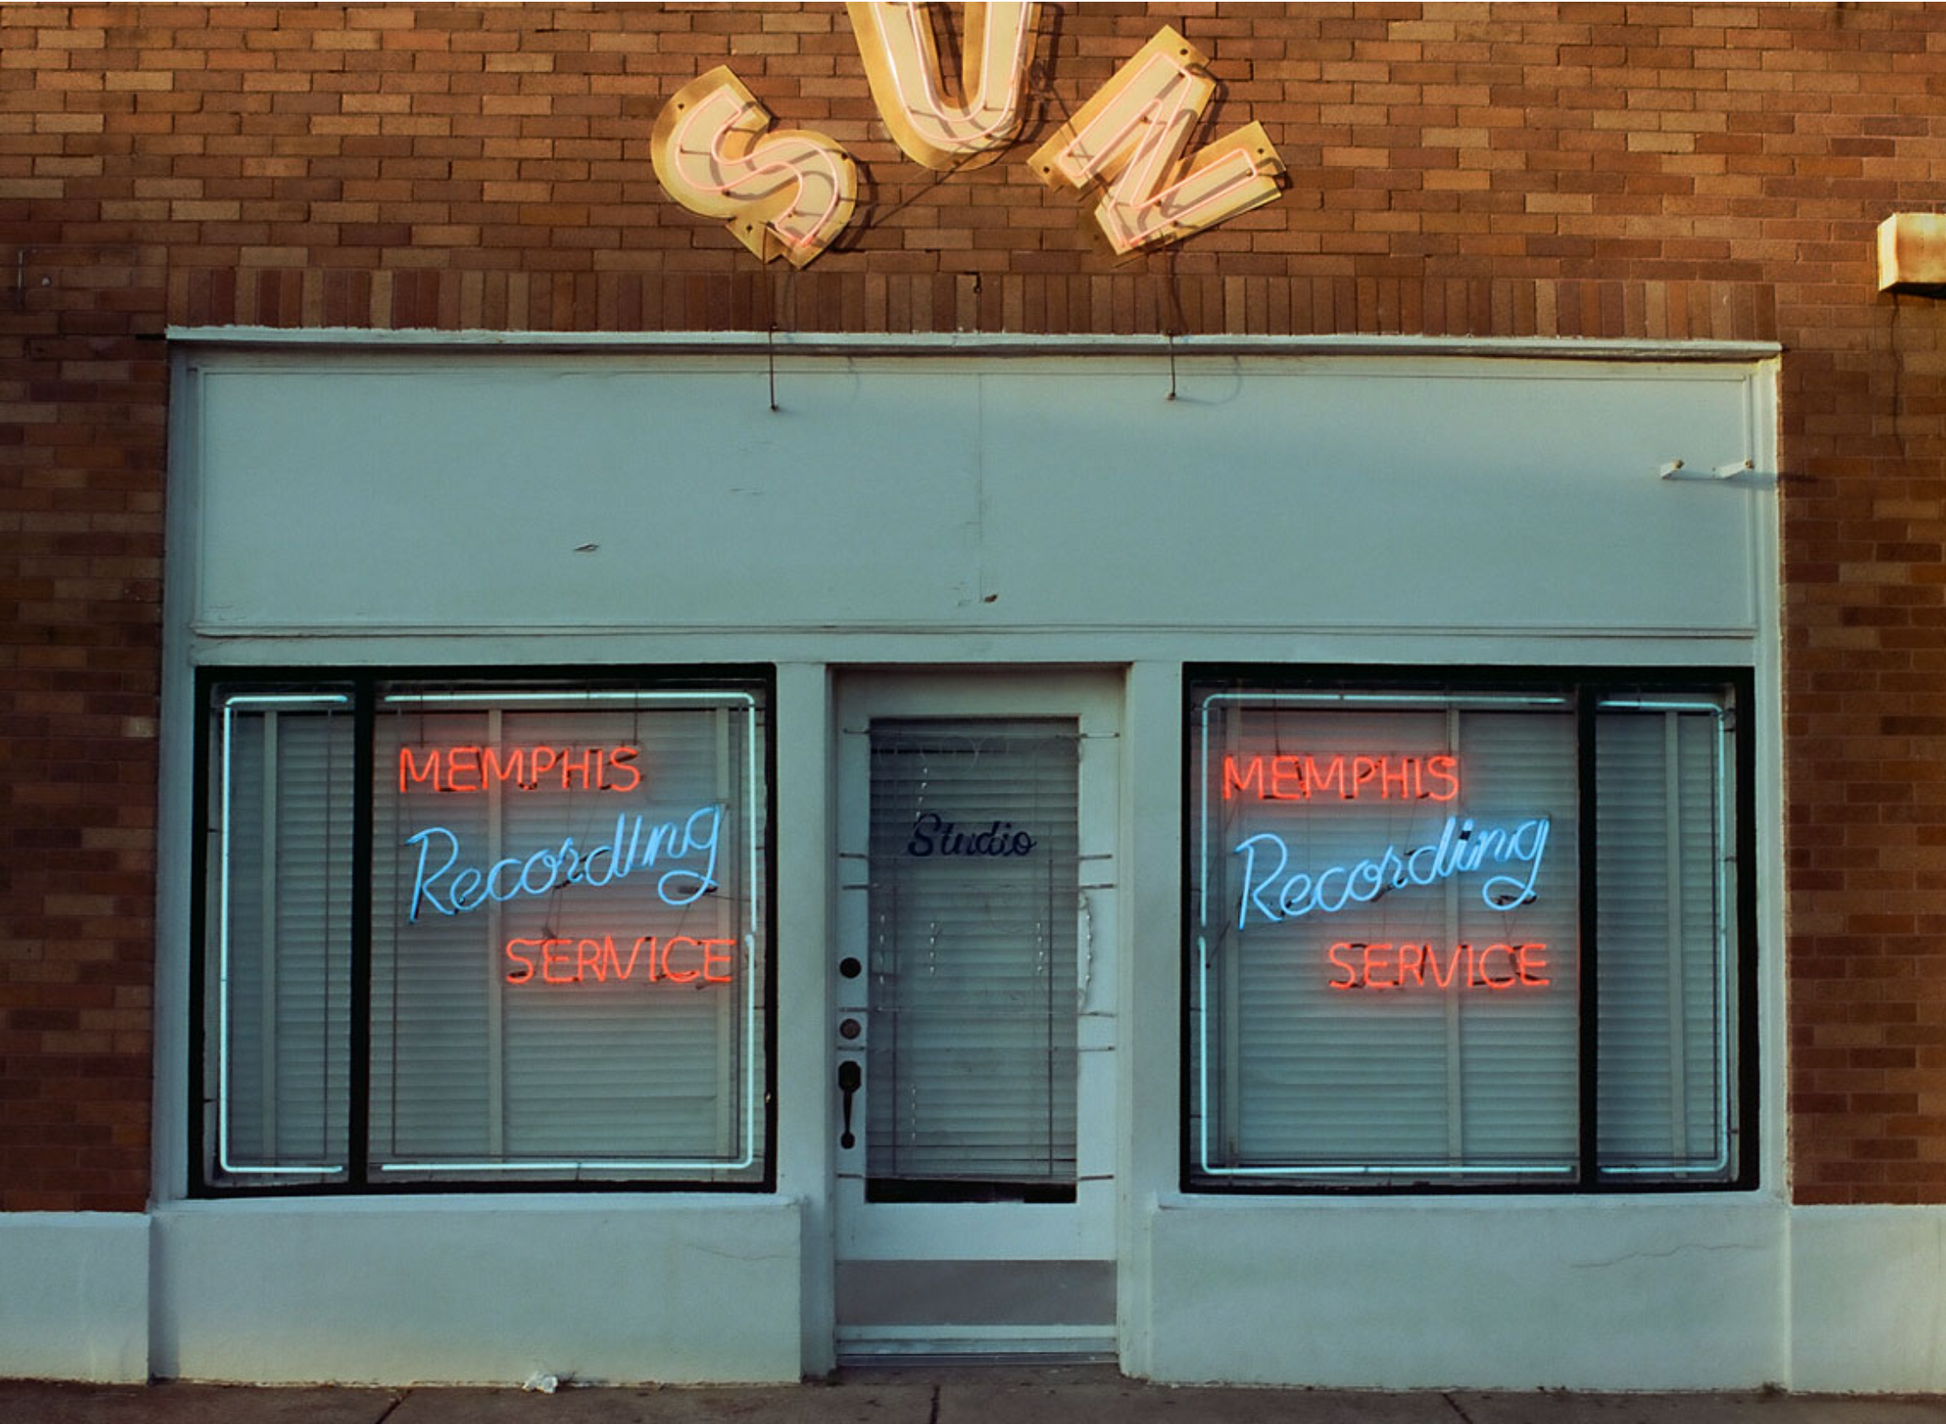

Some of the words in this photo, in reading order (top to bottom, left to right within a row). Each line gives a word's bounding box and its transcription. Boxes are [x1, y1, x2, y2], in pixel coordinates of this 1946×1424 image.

[399, 745, 643, 793] MEMPHIS
[1222, 755, 1461, 801] MEMPHIS
[908, 813, 1037, 857] Studio
[407, 803, 728, 924] Recording
[1234, 815, 1551, 930] Recording
[505, 936, 736, 983] SERVICE
[1327, 942, 1551, 989] SERVICE
